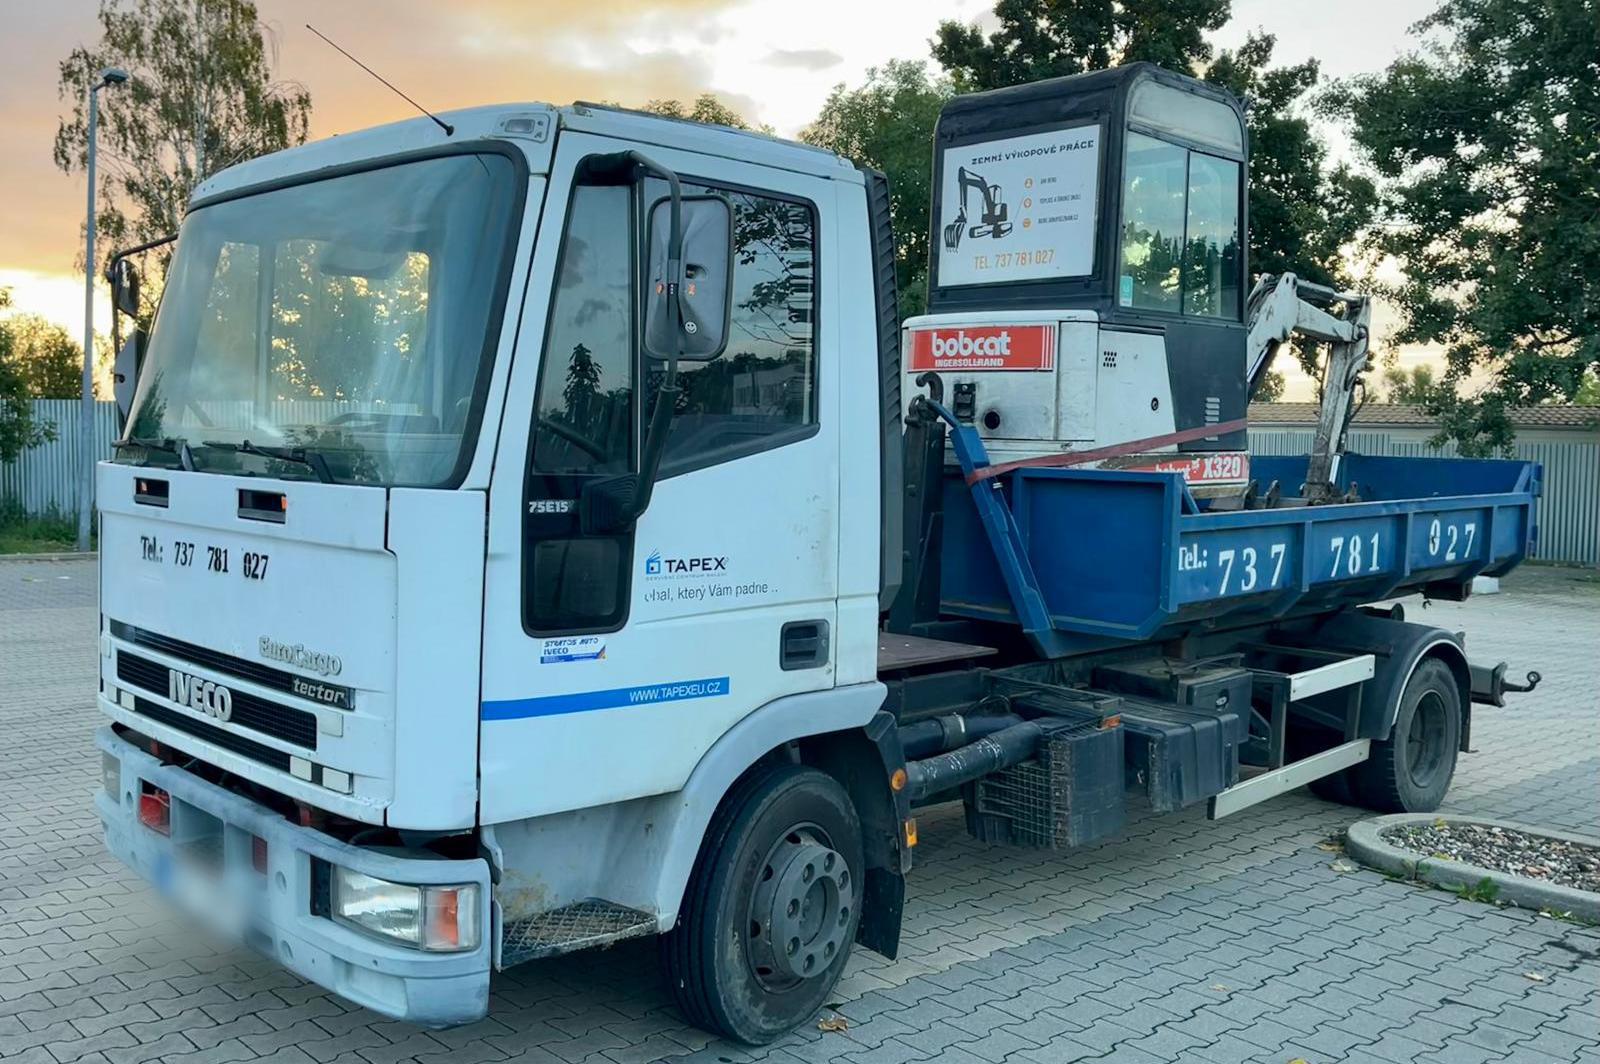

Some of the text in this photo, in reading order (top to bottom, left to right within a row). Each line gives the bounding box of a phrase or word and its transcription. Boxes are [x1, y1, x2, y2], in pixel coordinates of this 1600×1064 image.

[971, 140, 1094, 165] ZEMNÍ VÝKOPOVÉ PRÁCE
[995, 253, 1013, 268] 737
[1015, 251, 1032, 266] 781
[1035, 249, 1054, 264] 027
[931, 330, 1011, 357] bobcat
[1203, 456, 1241, 479] X320
[528, 501, 569, 514] 75E15
[140, 535, 269, 580] Tel.: 737 781 027
[665, 556, 726, 573] TAPEX
[1218, 543, 1286, 596] 737
[1330, 532, 1380, 578] 781
[1429, 519, 1476, 561] 027
[678, 584, 706, 601] který
[708, 583, 733, 597] Vám
[735, 581, 769, 598] padne
[258, 635, 343, 677] EuroCargo
[543, 647, 569, 655] IVECO
[168, 669, 232, 722] IVECO
[293, 678, 345, 703] tector
[629, 682, 721, 702] WWW.TAPEXEU.CZ
